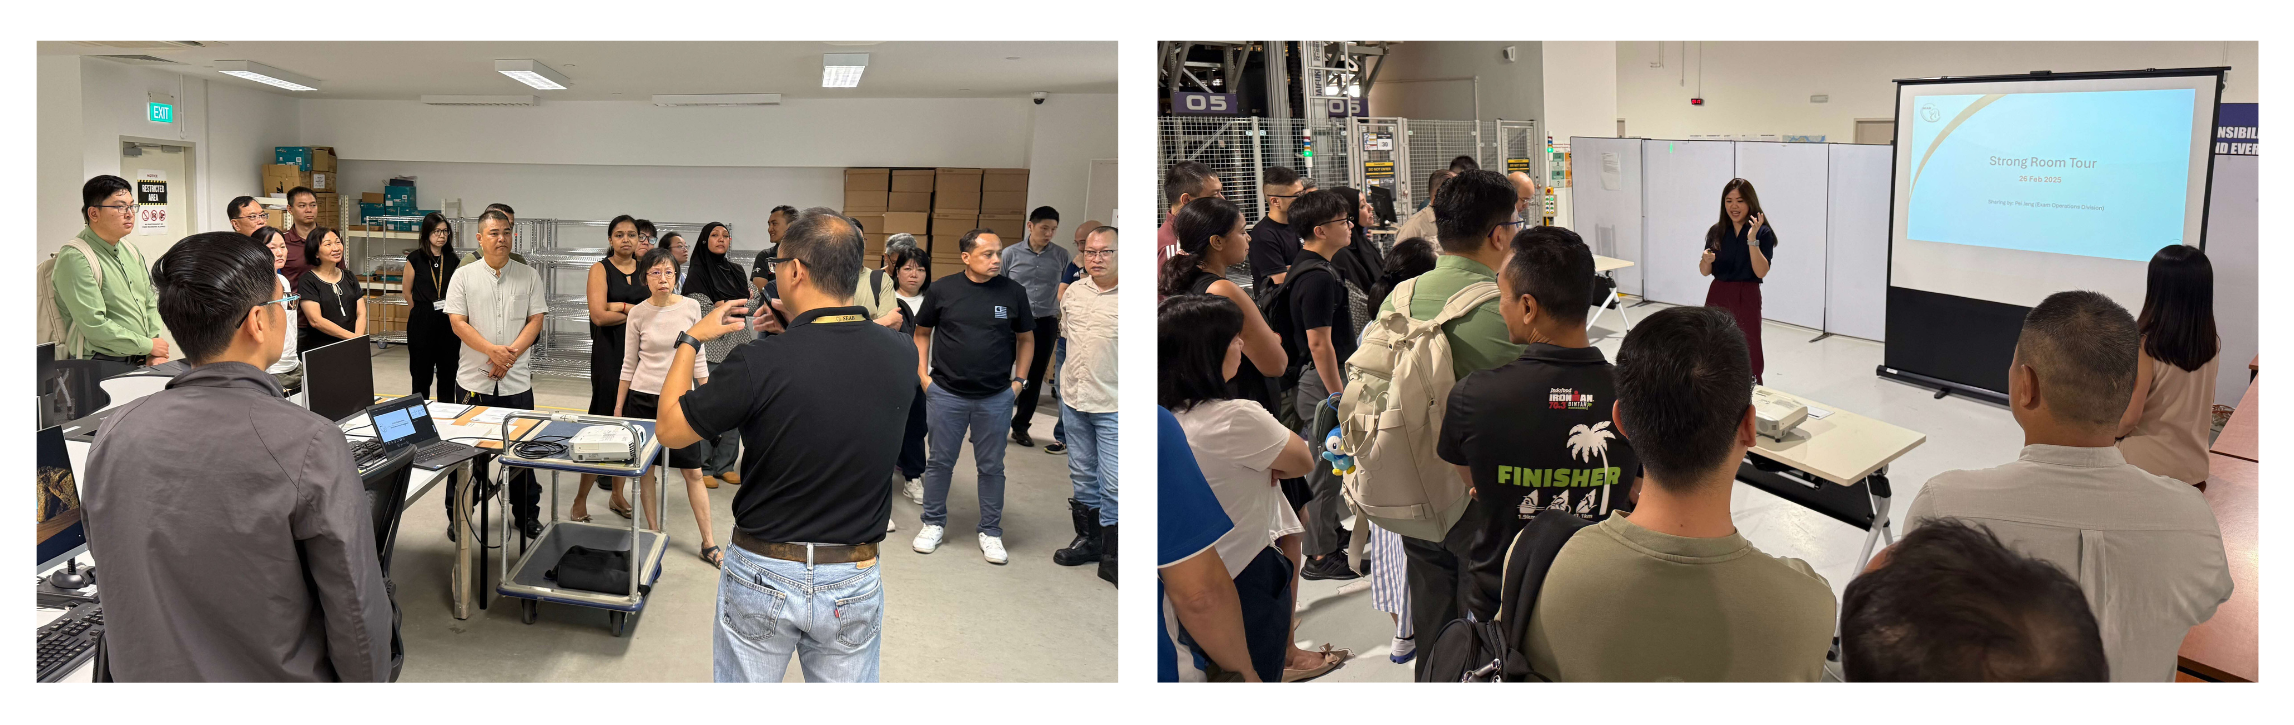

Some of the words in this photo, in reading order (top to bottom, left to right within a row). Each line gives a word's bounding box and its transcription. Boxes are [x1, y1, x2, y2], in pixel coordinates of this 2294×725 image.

[1186, 94, 1227, 111] 05
[1328, 99, 1361, 113] 05
[153, 105, 169, 120] EXIT
[2217, 126, 2259, 139] NSIBIL
[1989, 156, 2028, 169] Strong
[2030, 156, 2067, 168] Room
[2069, 157, 2098, 169] Tour
[142, 184, 165, 193] RESTRICTED
[148, 193, 159, 202] AREA
[1549, 402, 1566, 410] 70.3
[1498, 465, 1621, 488] FINISHER
